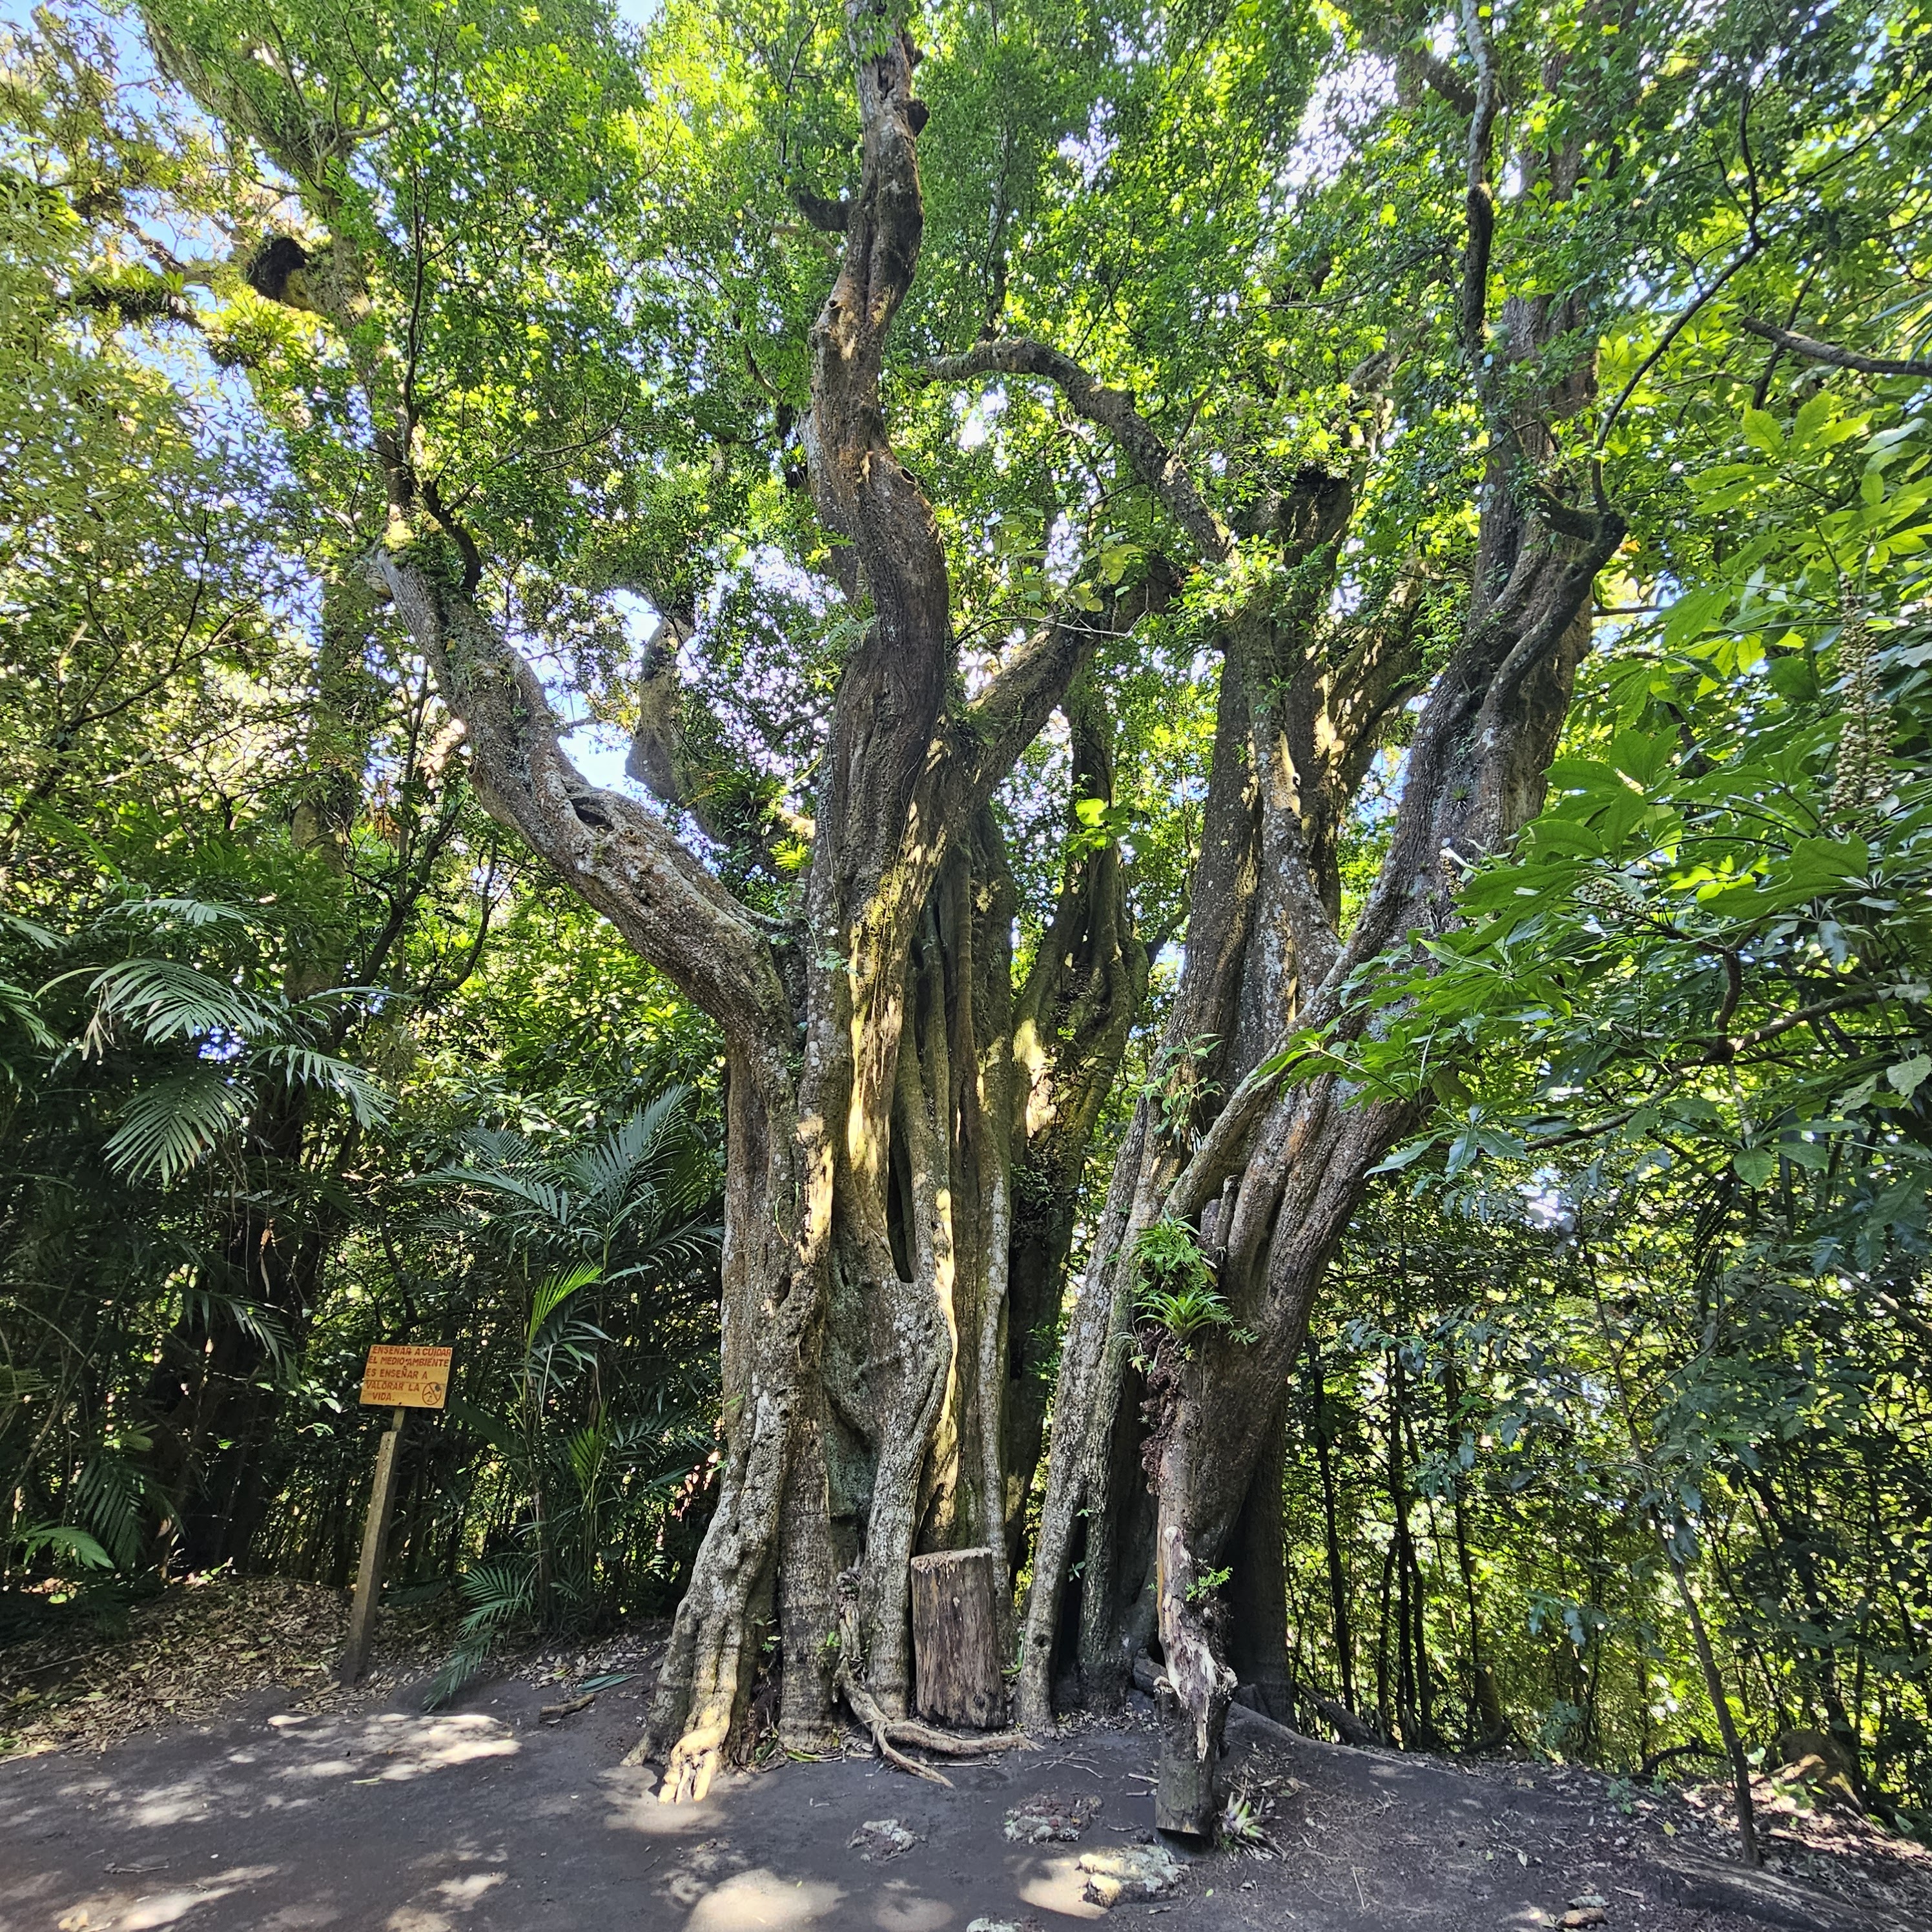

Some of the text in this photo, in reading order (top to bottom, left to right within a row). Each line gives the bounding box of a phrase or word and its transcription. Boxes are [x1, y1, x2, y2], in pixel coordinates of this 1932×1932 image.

[414, 1347, 420, 1355] A
[422, 1348, 451, 1357] CUIDAR
[380, 1357, 405, 1365] MEDIO
[406, 1358, 450, 1367] AMBIENTE
[365, 1366, 427, 1379] ES ENSEÑAR A
[365, 1381, 419, 1392] VALORAR LA
